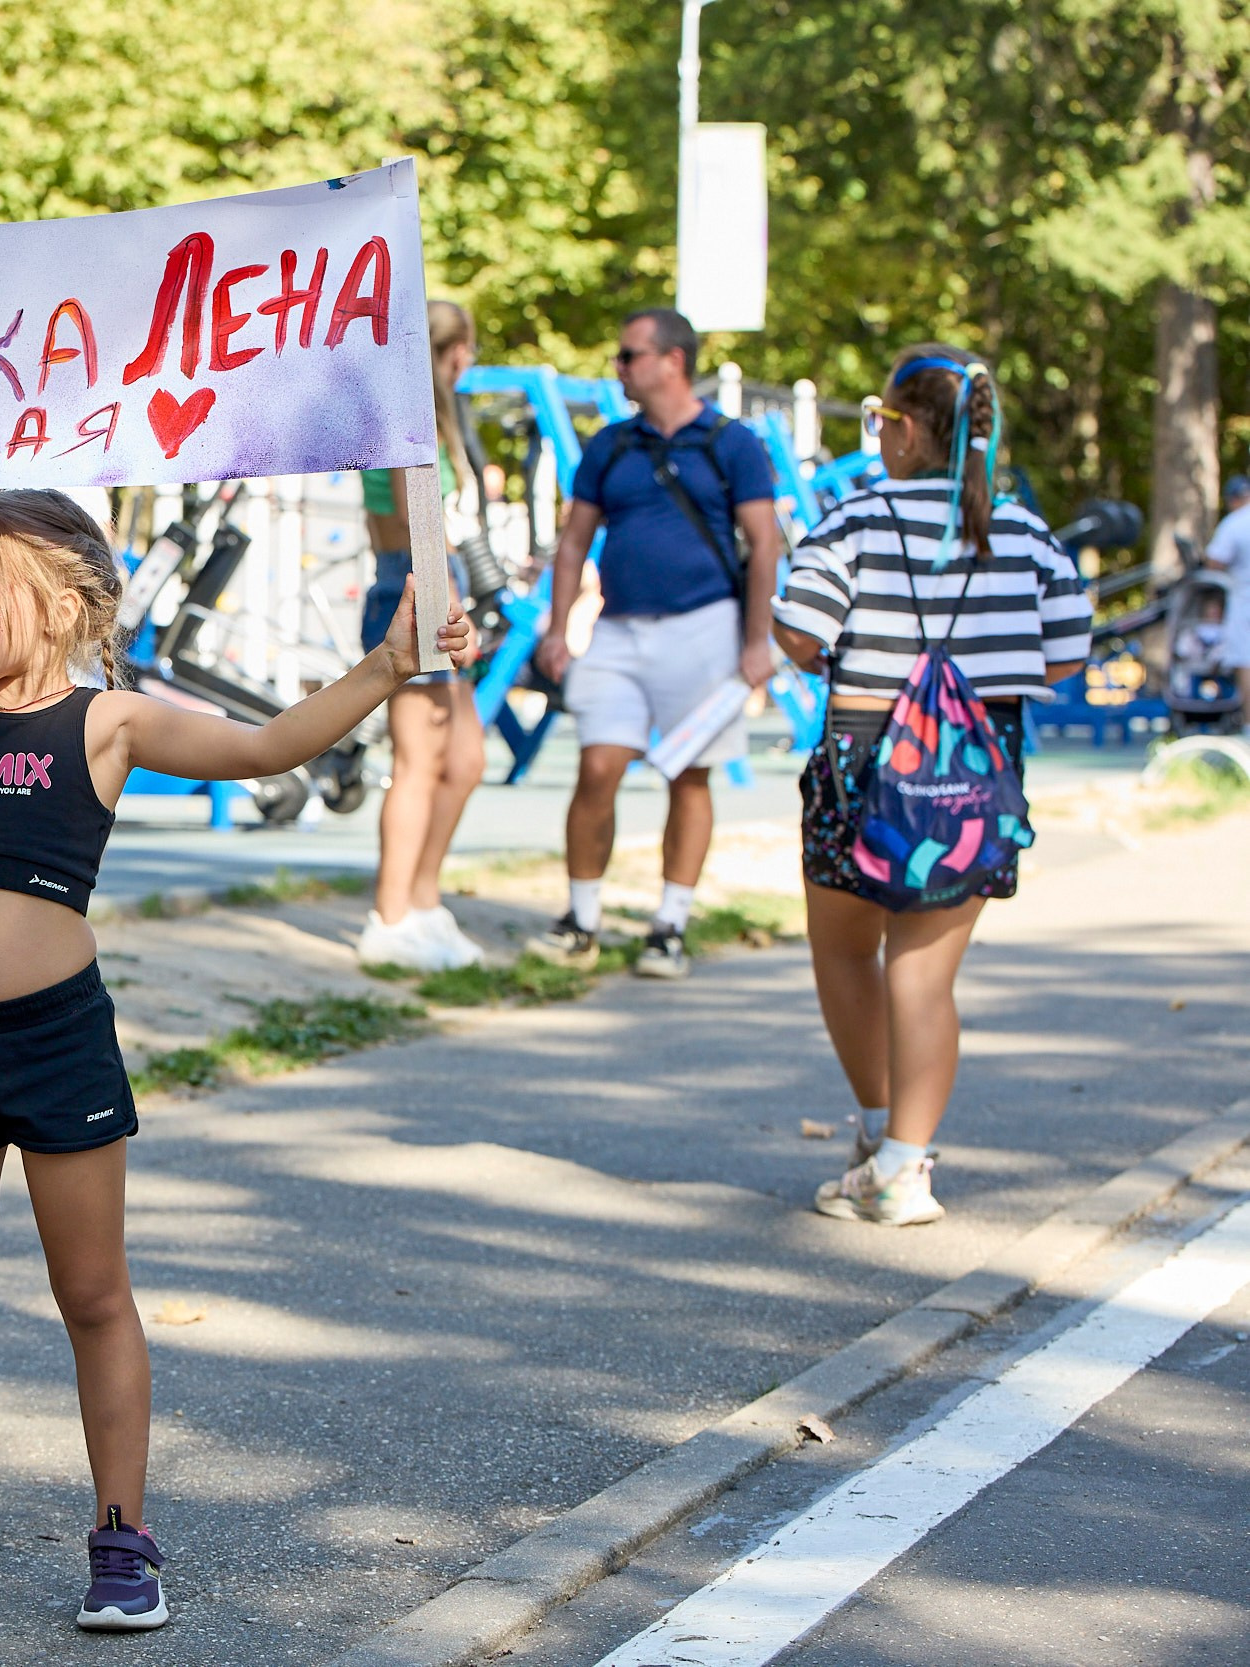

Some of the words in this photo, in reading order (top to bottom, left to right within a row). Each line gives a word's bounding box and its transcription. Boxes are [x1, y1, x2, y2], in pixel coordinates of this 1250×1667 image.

[122, 231, 390, 387] ЛЕНА
[0, 787, 15, 795] YOU
[16, 787, 32, 796] ARE
[39, 879, 69, 893] DEMIX
[86, 1107, 115, 1123] DEMIX
